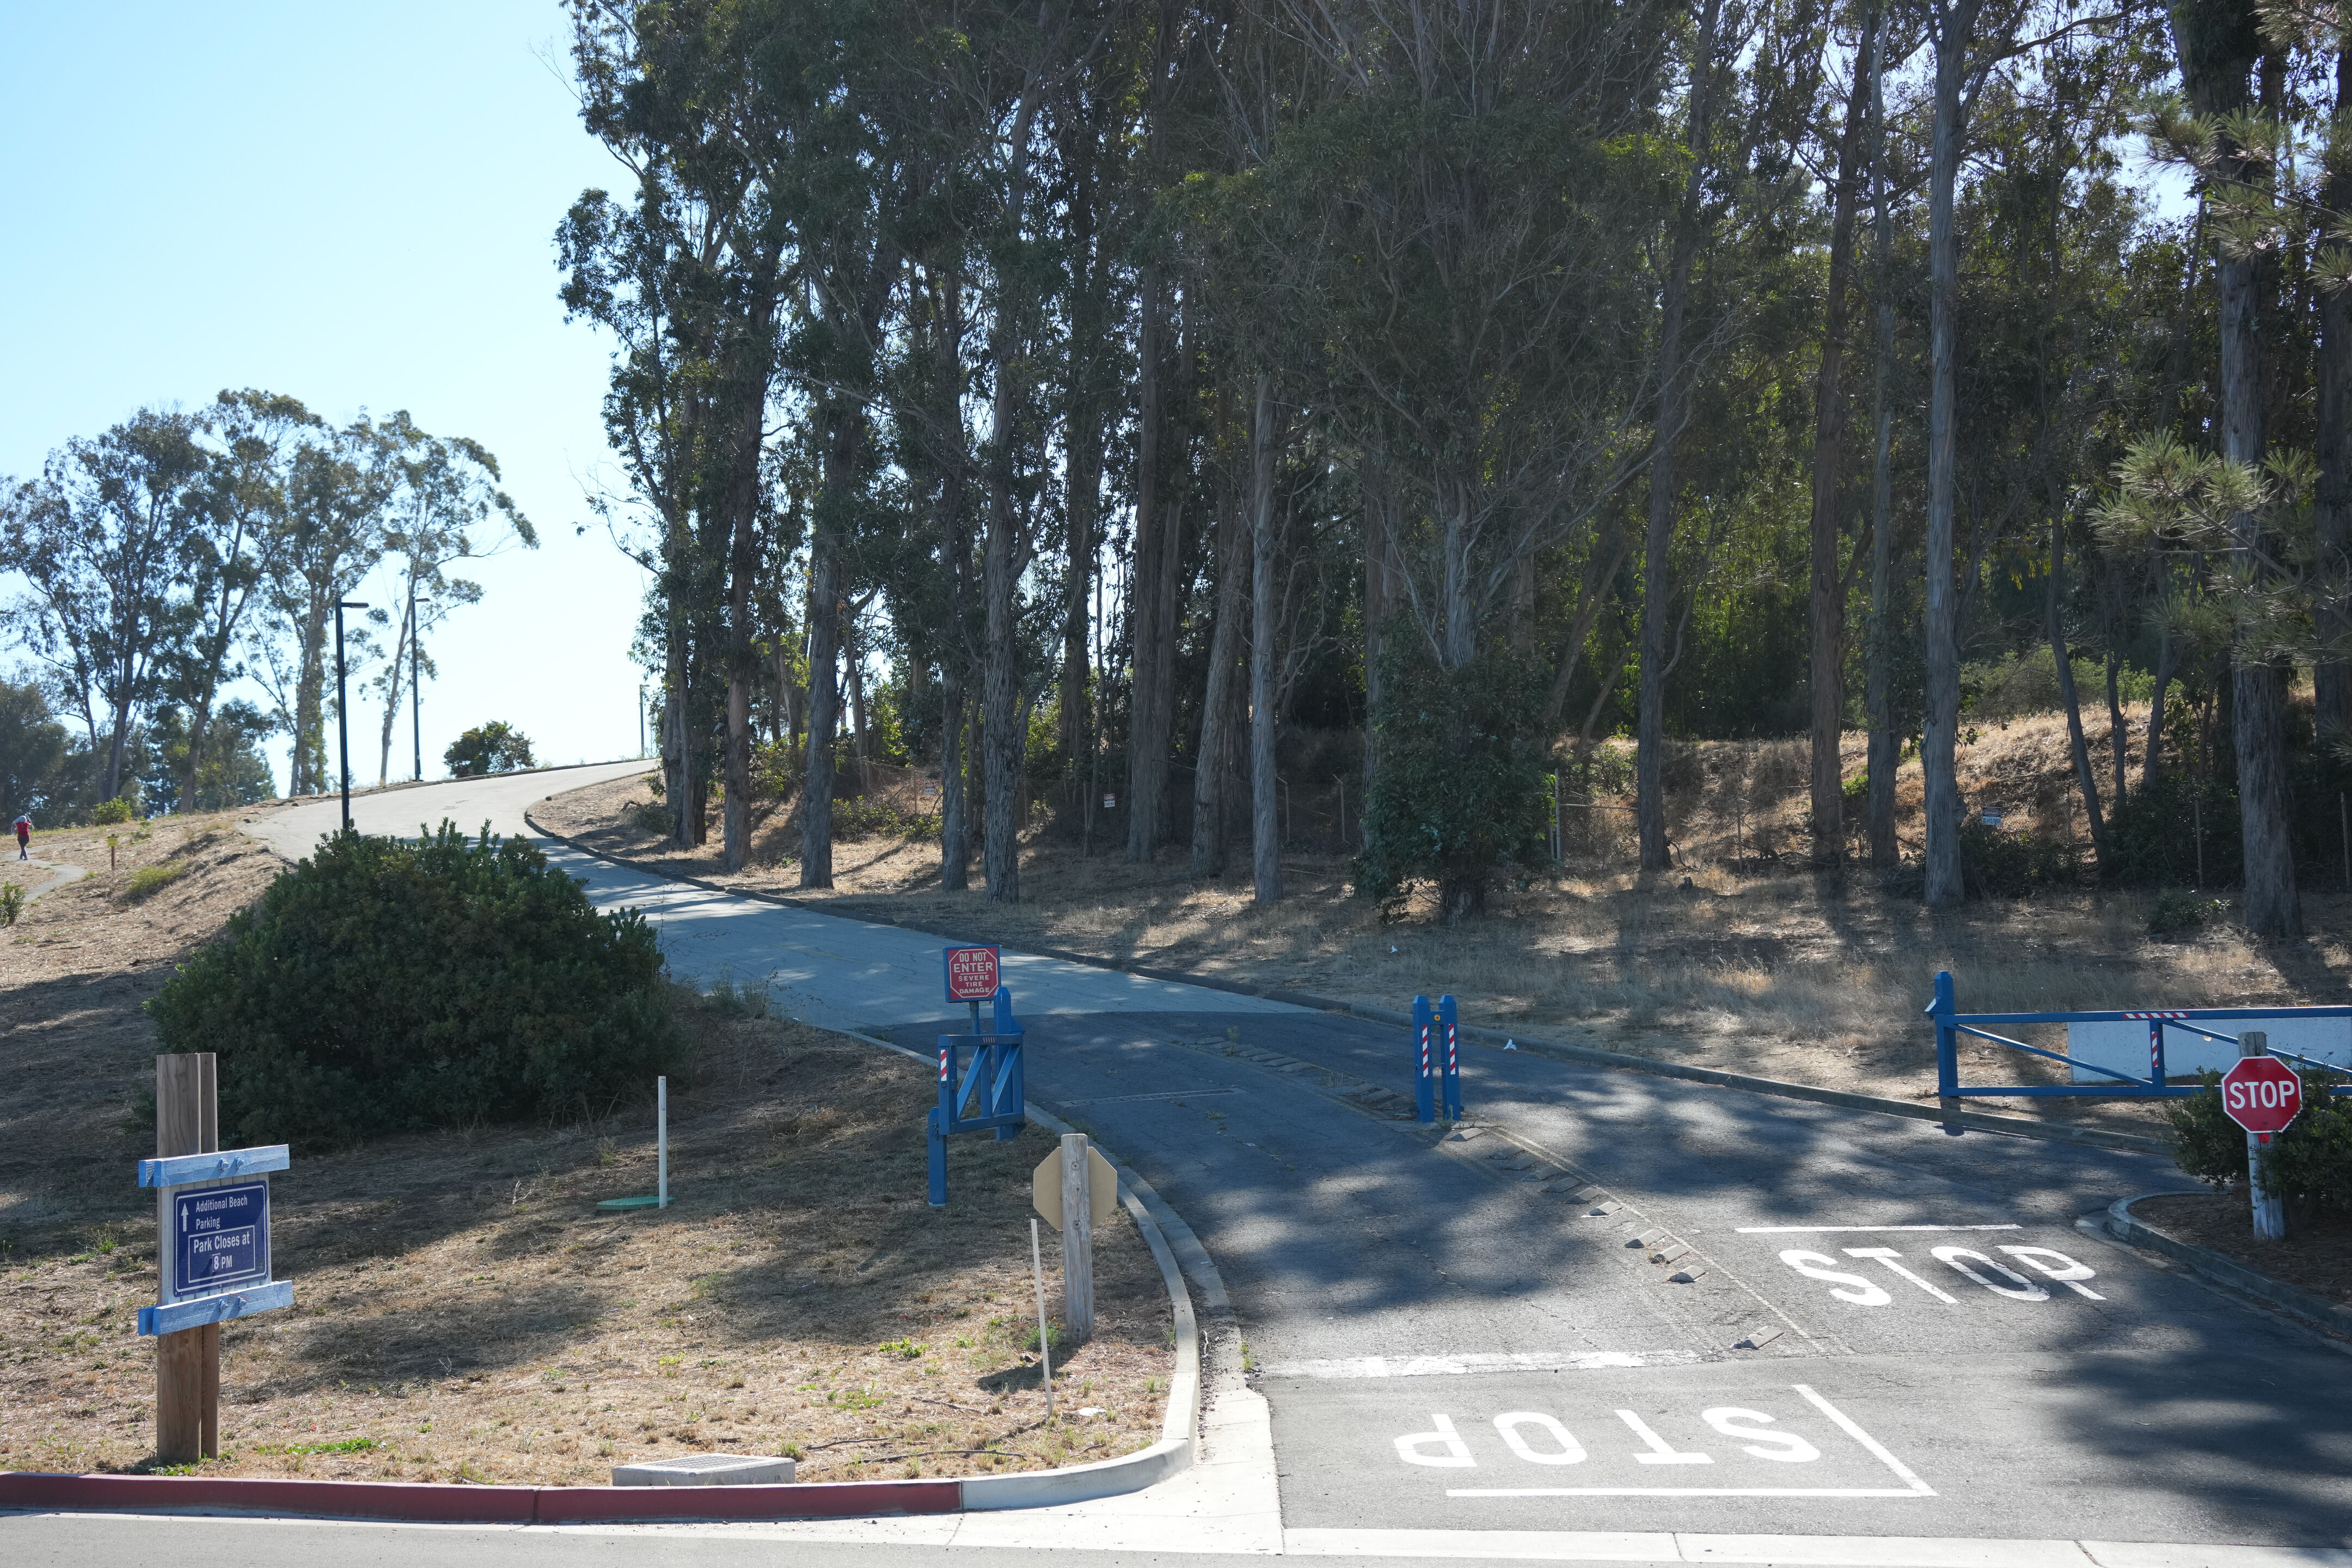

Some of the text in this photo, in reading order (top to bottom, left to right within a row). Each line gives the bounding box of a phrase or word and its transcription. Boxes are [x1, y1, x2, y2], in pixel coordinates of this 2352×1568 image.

[959, 952, 987, 963] DO NOT
[953, 961, 994, 973] ENTER
[2230, 1080, 2295, 1109] STOP
[195, 1195, 248, 1212] Additional Beach
[196, 1216, 220, 1230] Parking
[194, 1231, 250, 1253] Park Closes at
[213, 1254, 232, 1270] 8 PM
[1779, 1245, 2106, 1306] STOP
[1394, 1407, 1821, 1467] STOP
